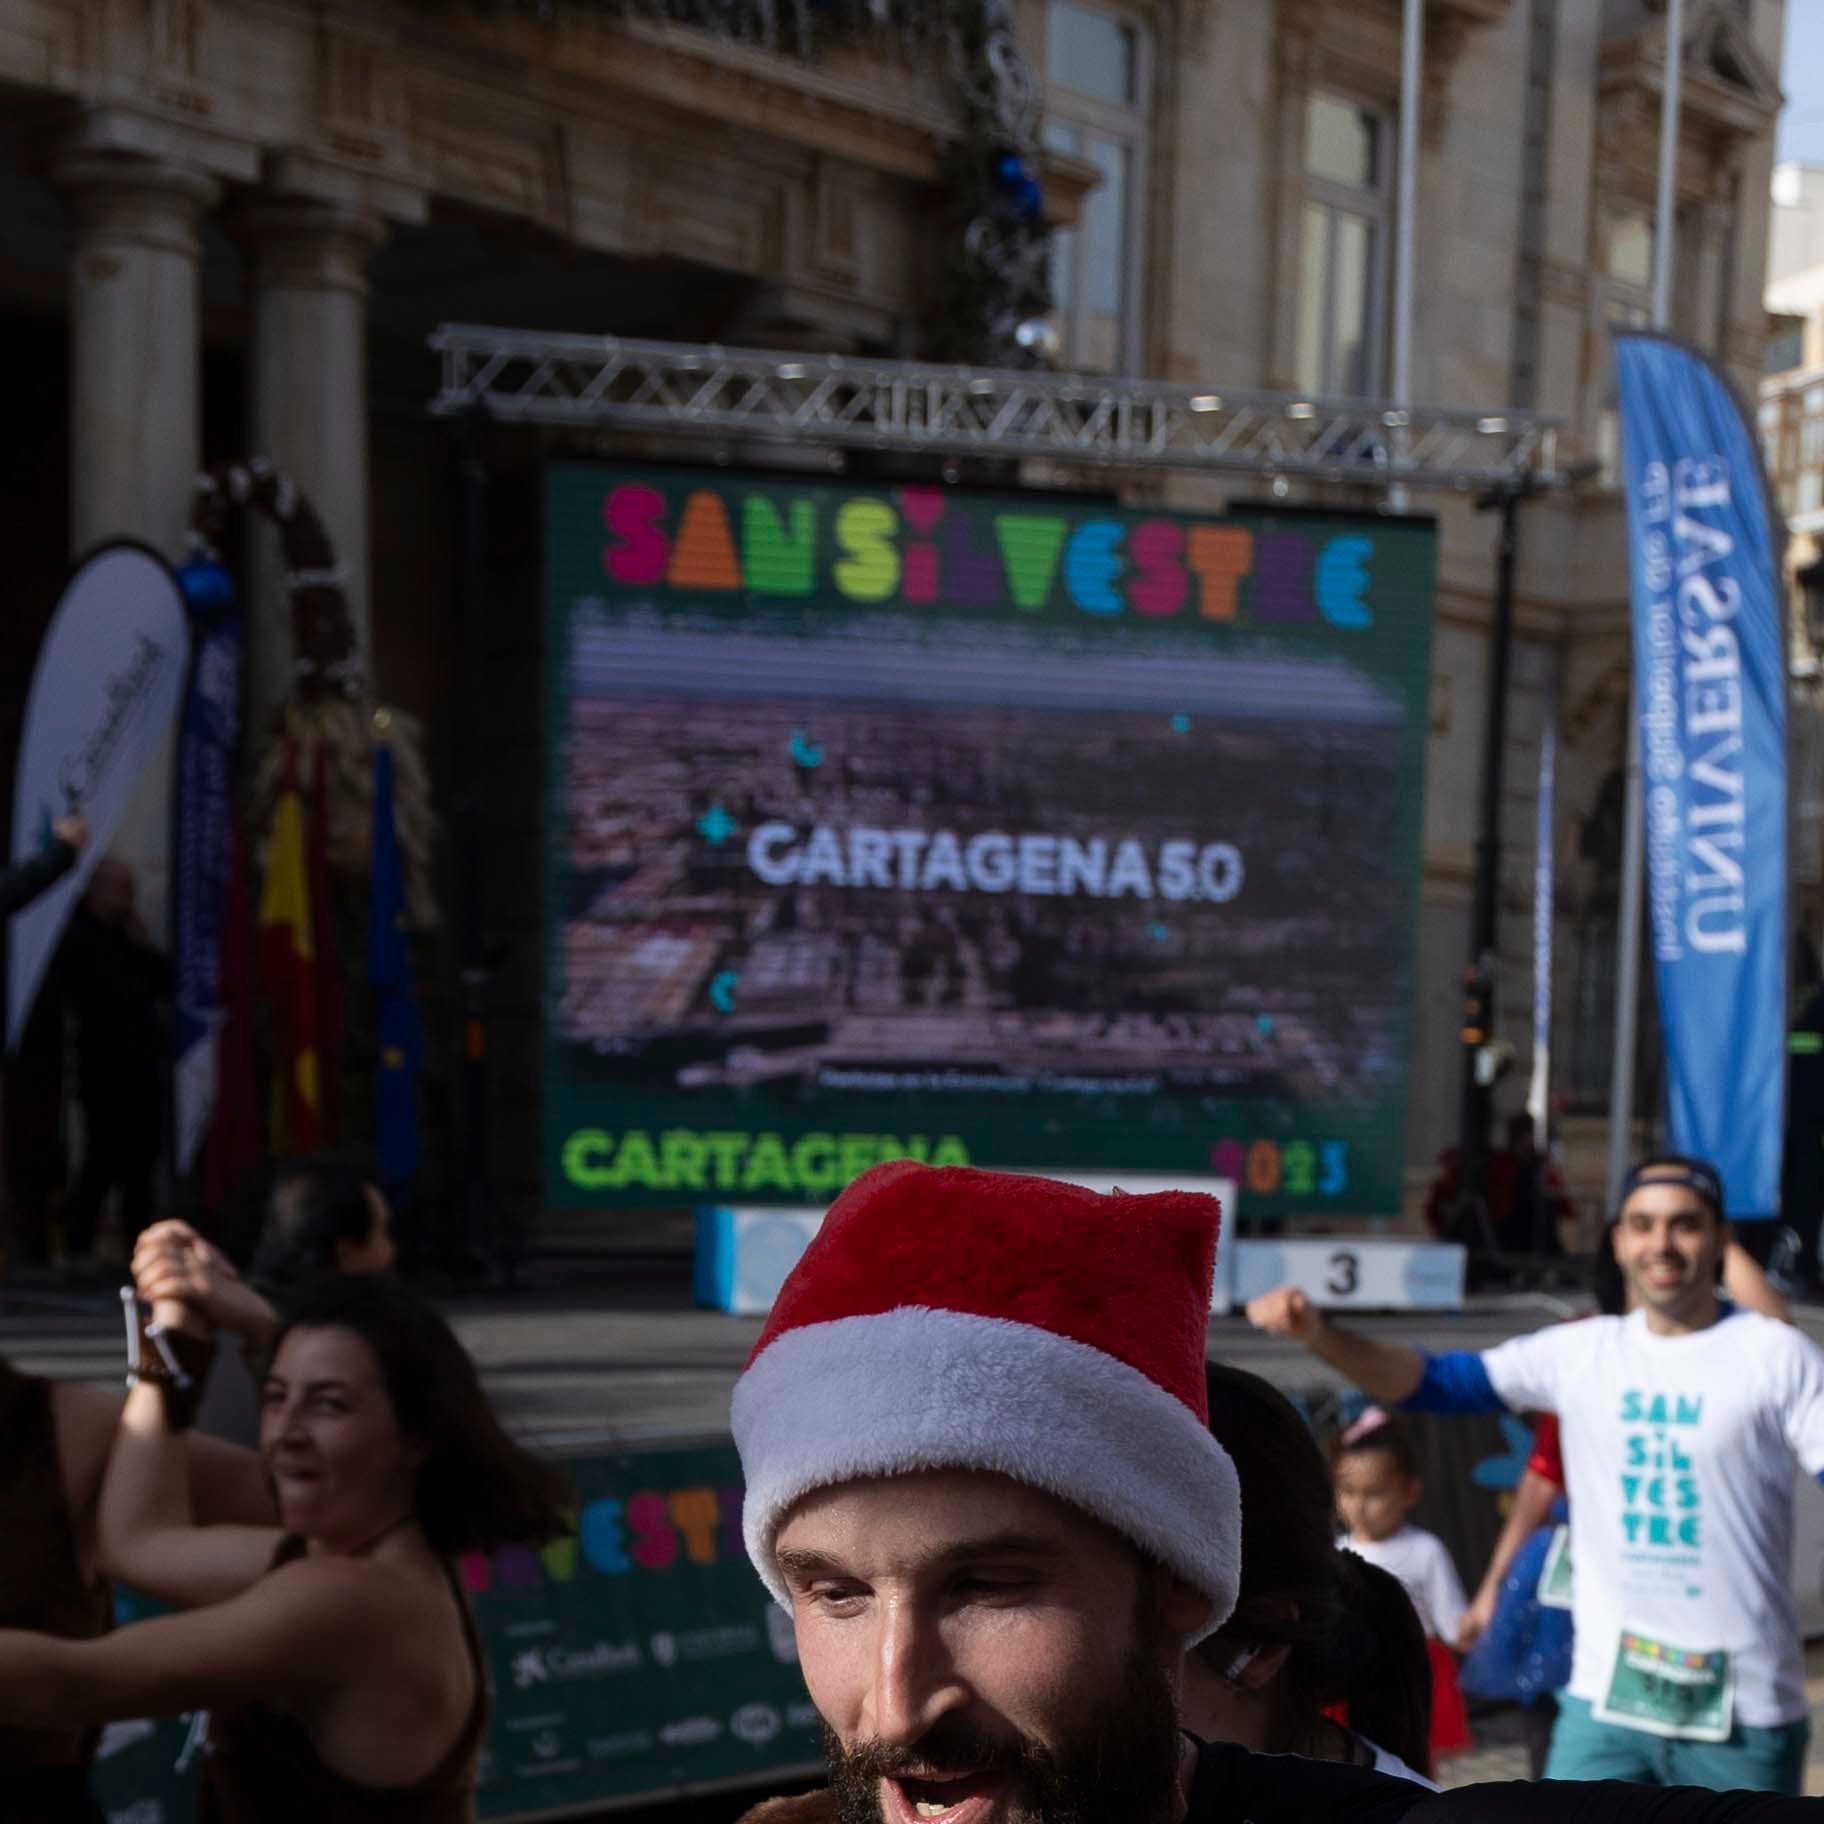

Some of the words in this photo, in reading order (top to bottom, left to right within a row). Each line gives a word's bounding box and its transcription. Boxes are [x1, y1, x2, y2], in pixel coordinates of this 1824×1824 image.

[604, 484, 816, 592] SAN
[747, 823, 1154, 899] CARTAGENA
[1327, 1252, 1360, 1295] 3
[1620, 1392, 1704, 1424] SAN
[1621, 1475, 1700, 1507] VES
[1622, 1513, 1700, 1547] TRE
